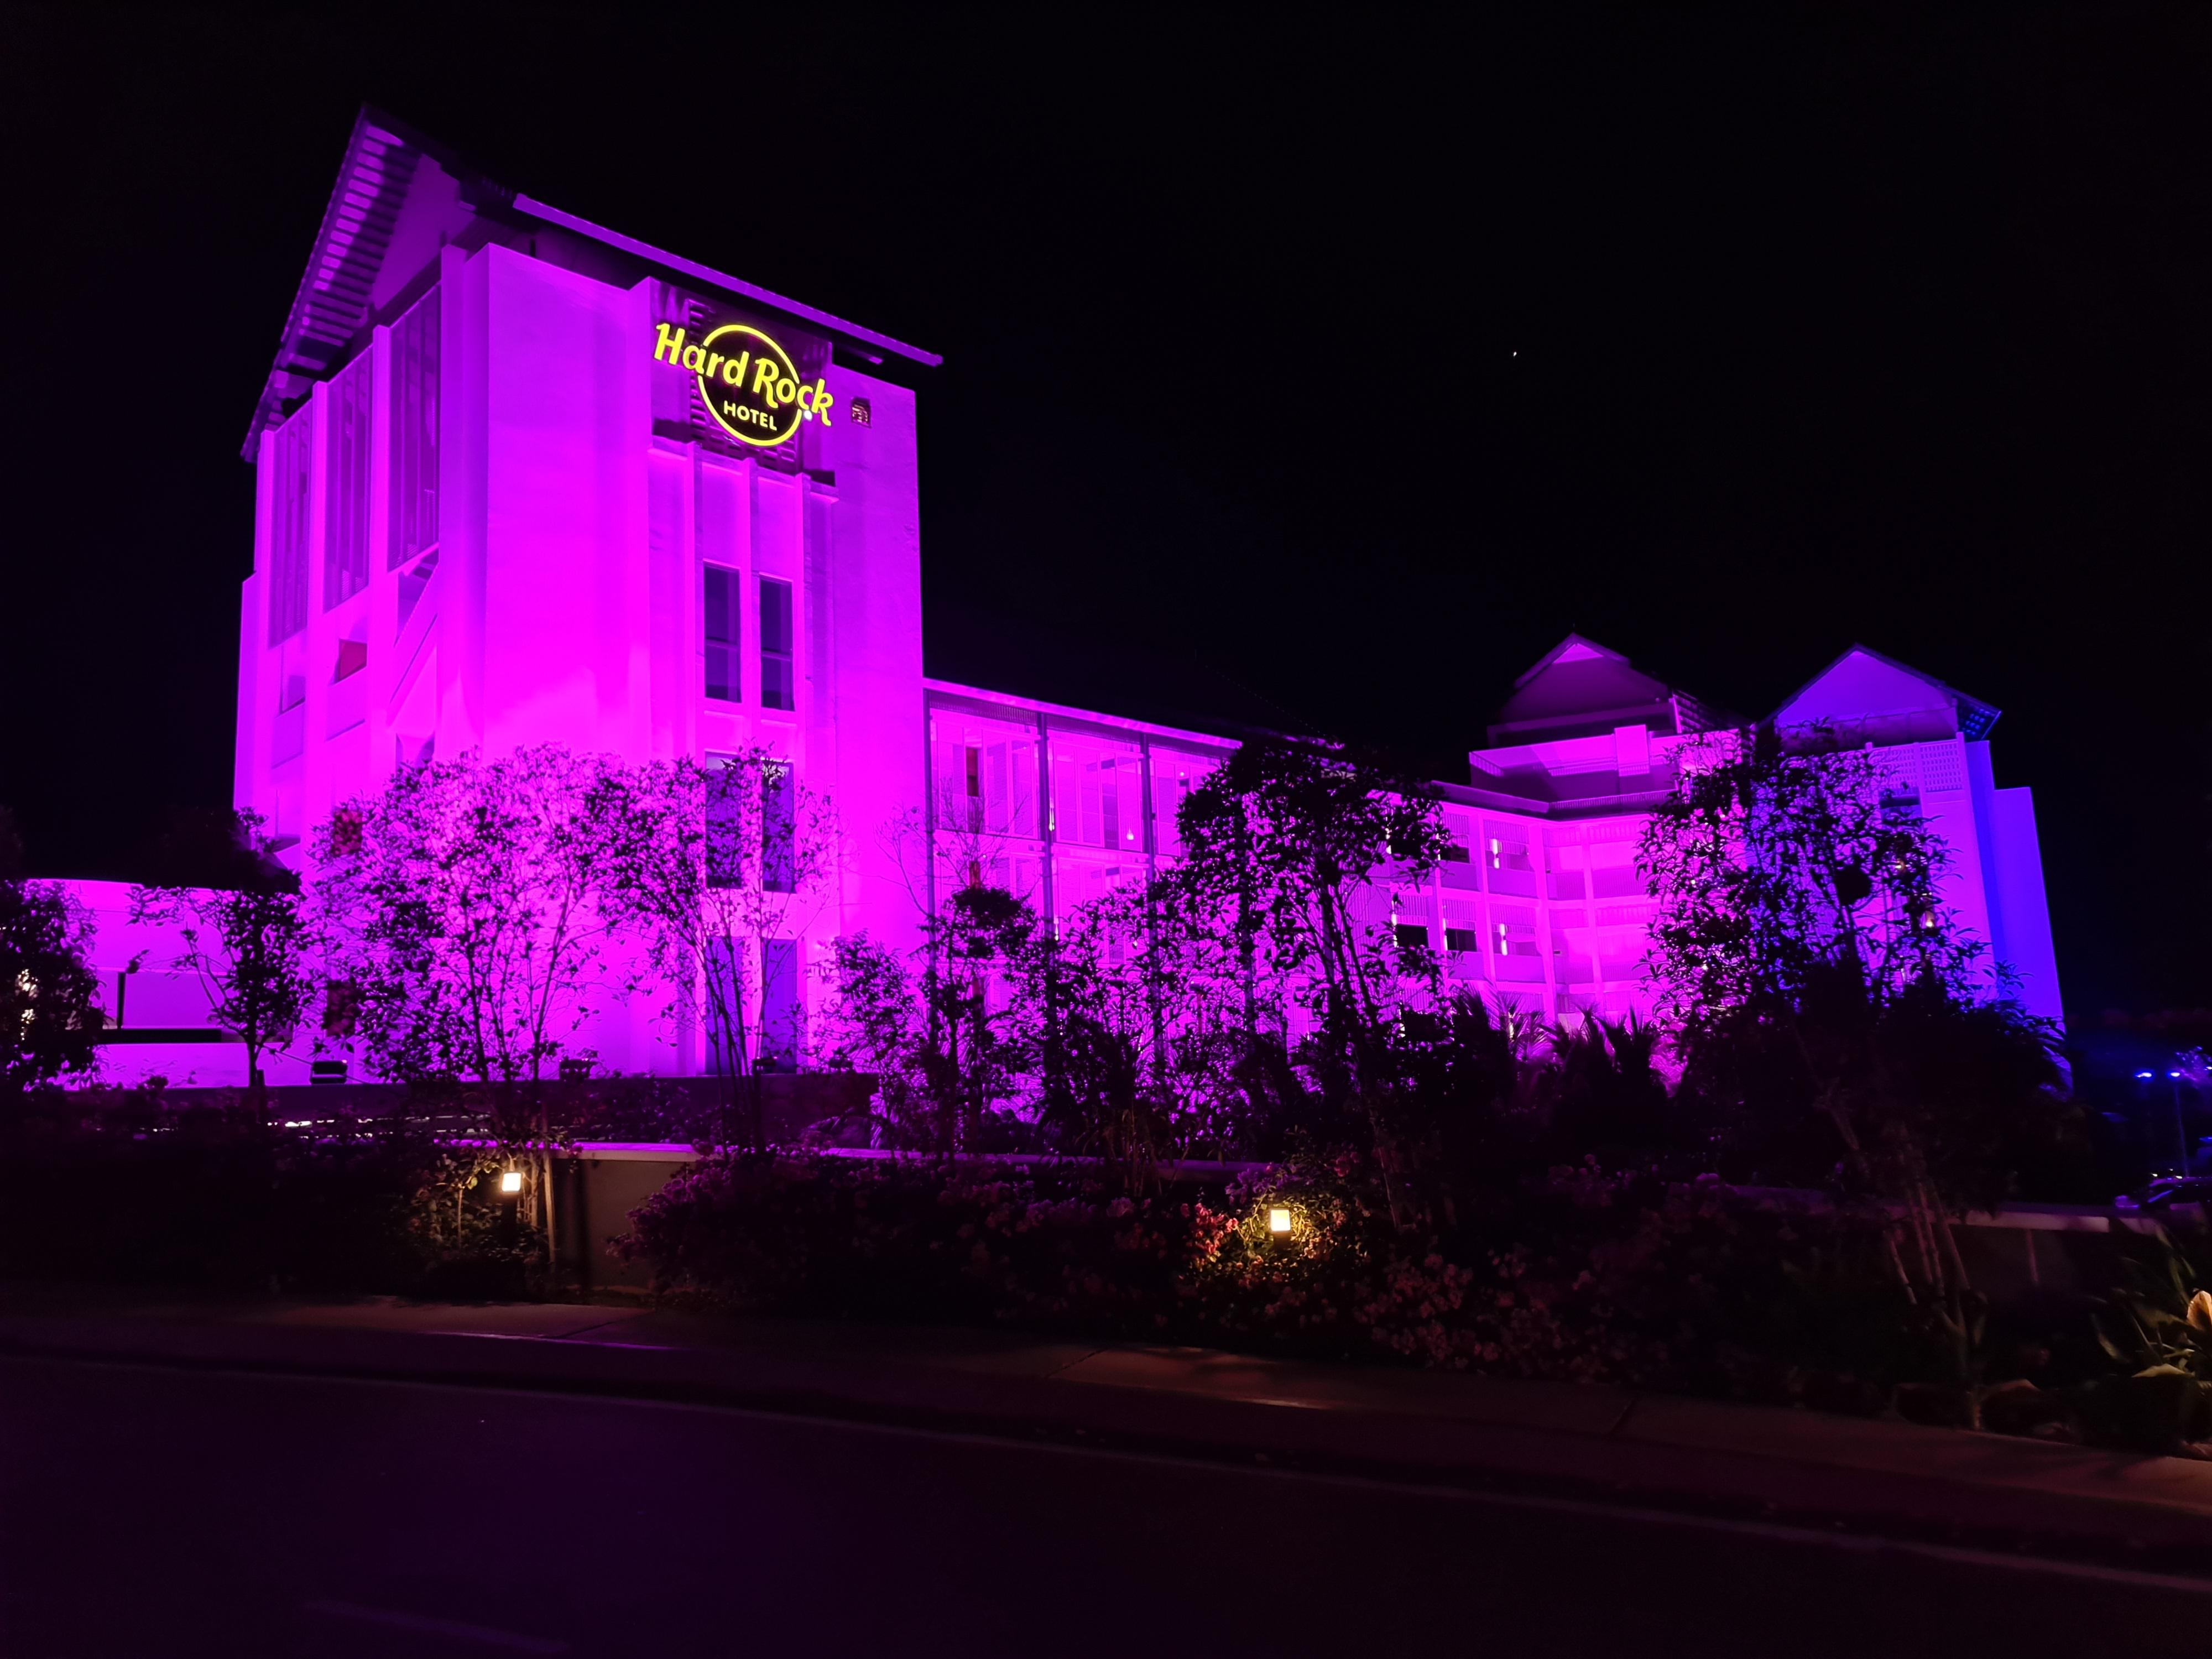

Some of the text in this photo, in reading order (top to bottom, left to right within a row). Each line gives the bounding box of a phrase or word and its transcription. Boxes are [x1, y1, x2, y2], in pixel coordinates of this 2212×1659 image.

[654, 323, 833, 426] Hard Rock
[723, 400, 778, 431] HOTEL
